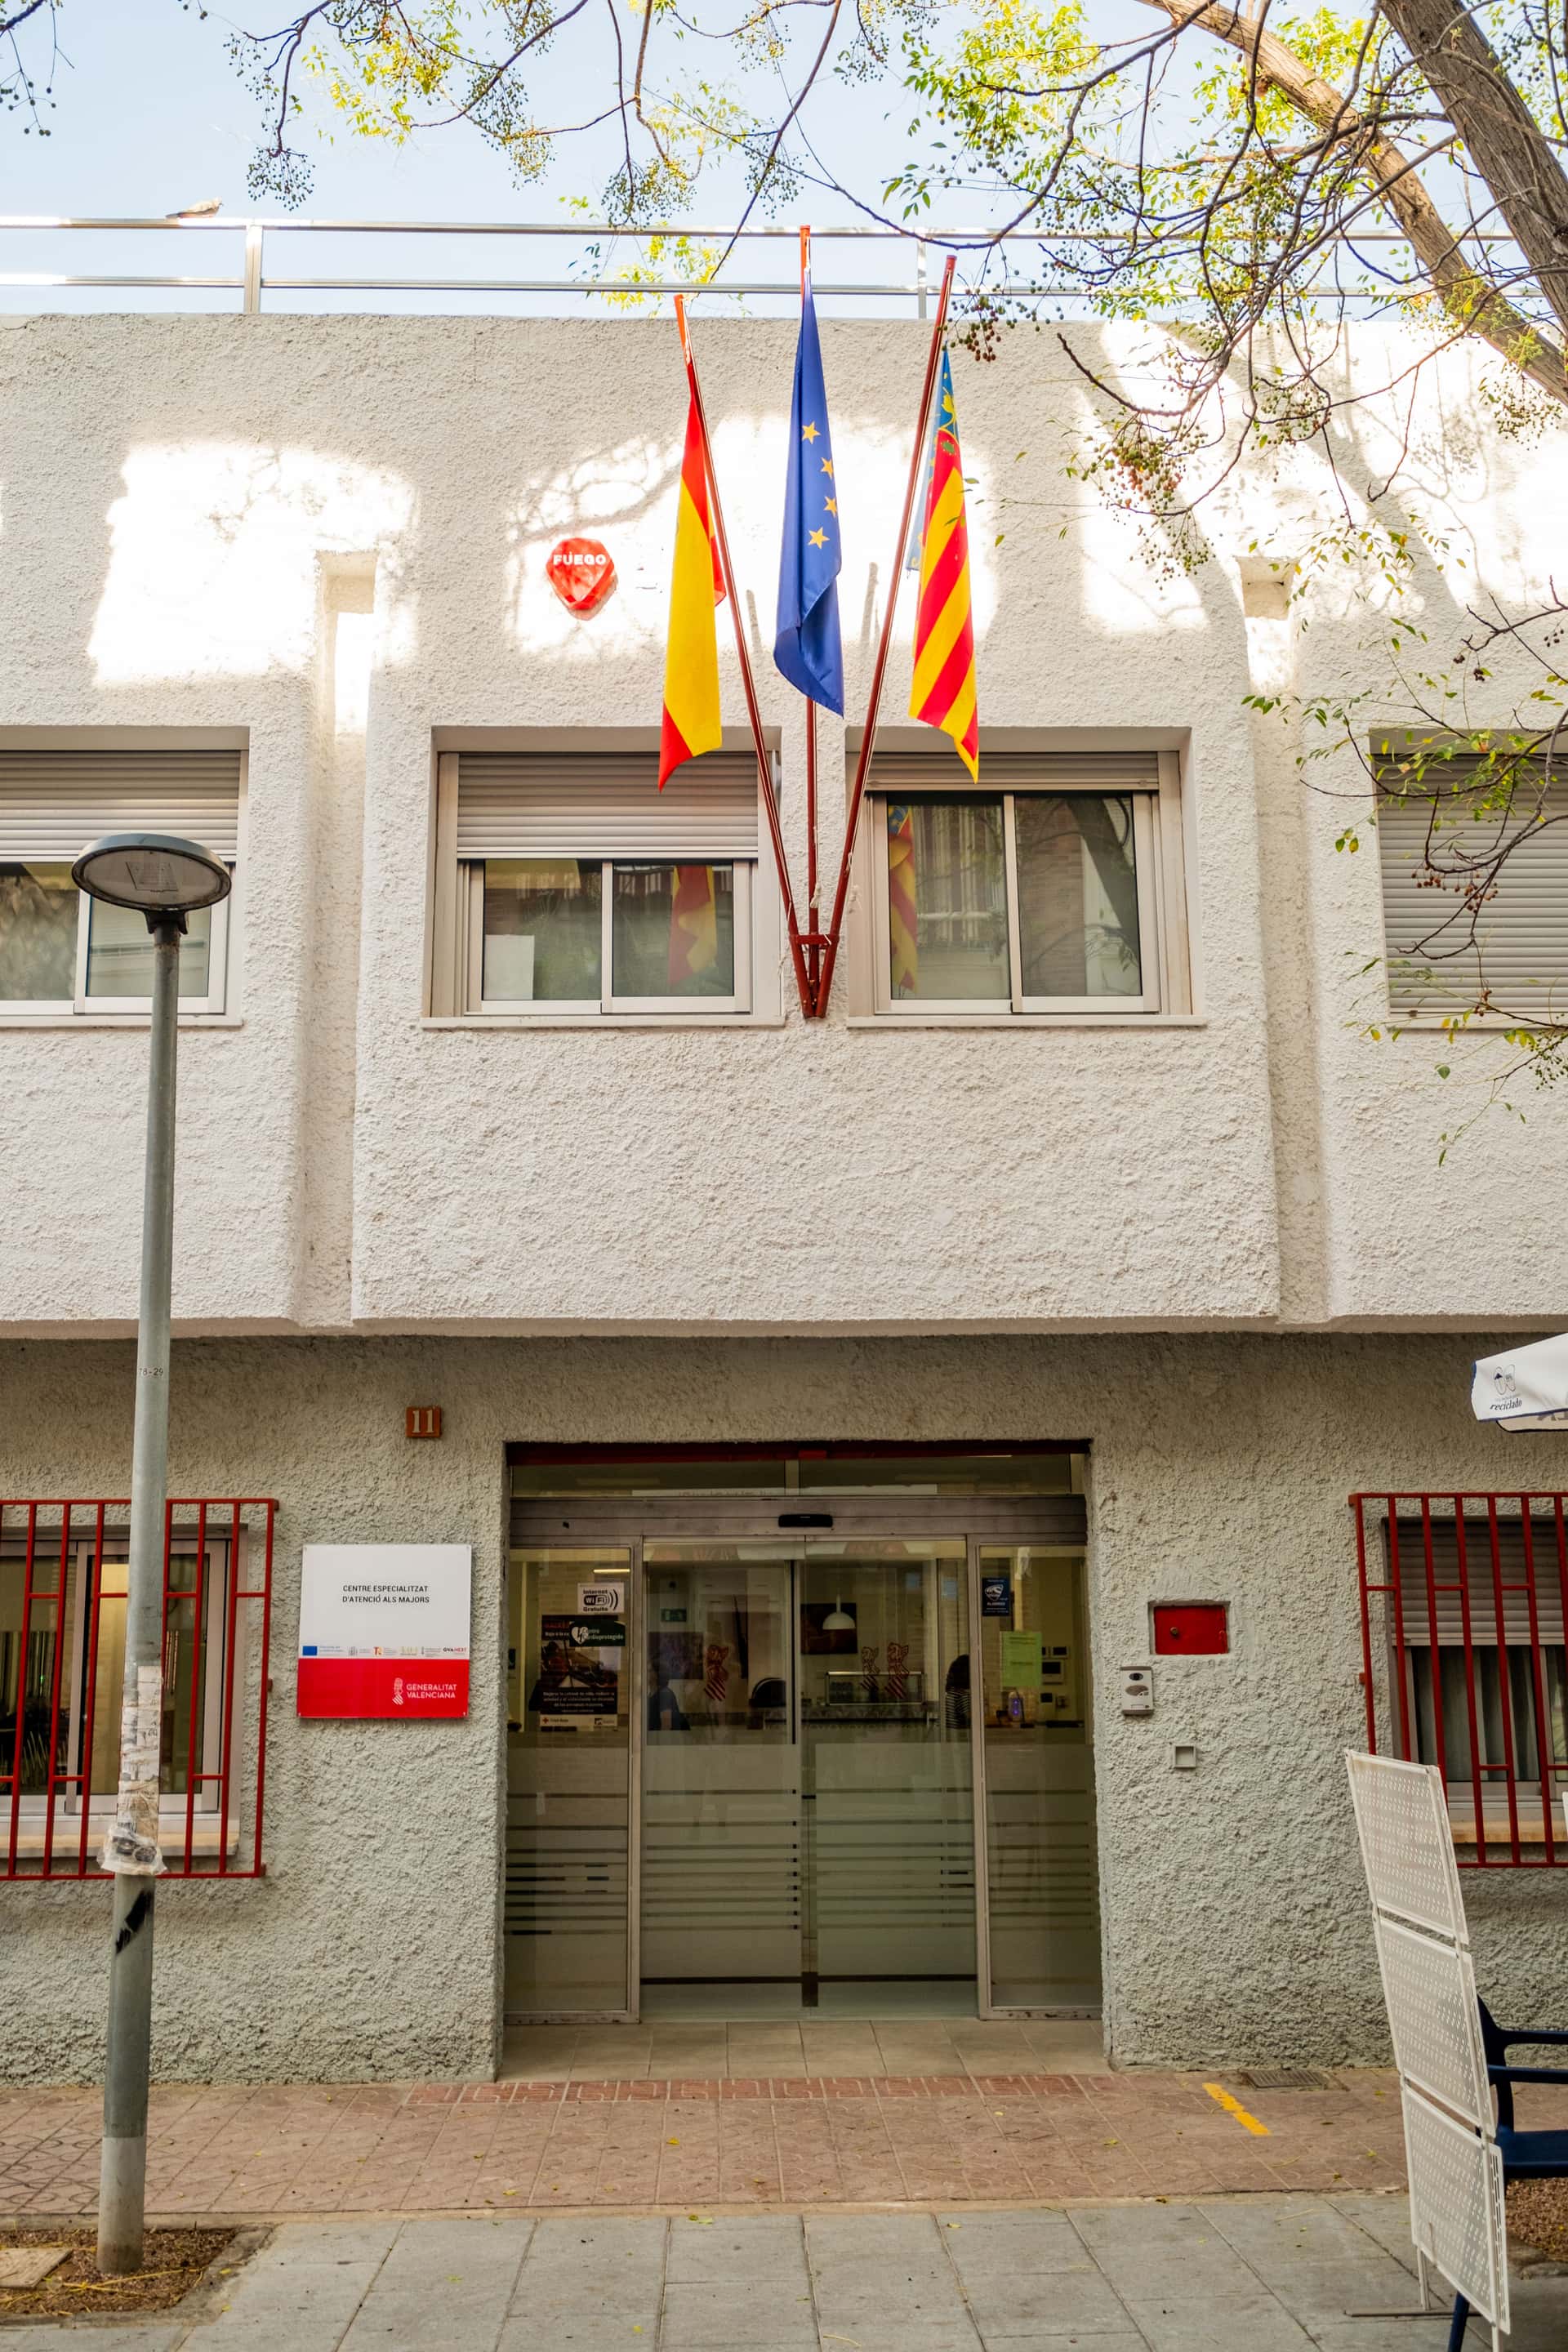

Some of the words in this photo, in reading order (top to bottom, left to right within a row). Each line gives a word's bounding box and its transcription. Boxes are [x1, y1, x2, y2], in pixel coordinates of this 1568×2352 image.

[553, 554, 607, 565] FUEGO
[1489, 1397, 1522, 1411] reciclado
[412, 1410, 434, 1433] 11
[342, 1594, 381, 1603] D'ATENCIÓ
[406, 1683, 457, 1691] GENERALITAT
[407, 1690, 456, 1699] VALENCIANA
